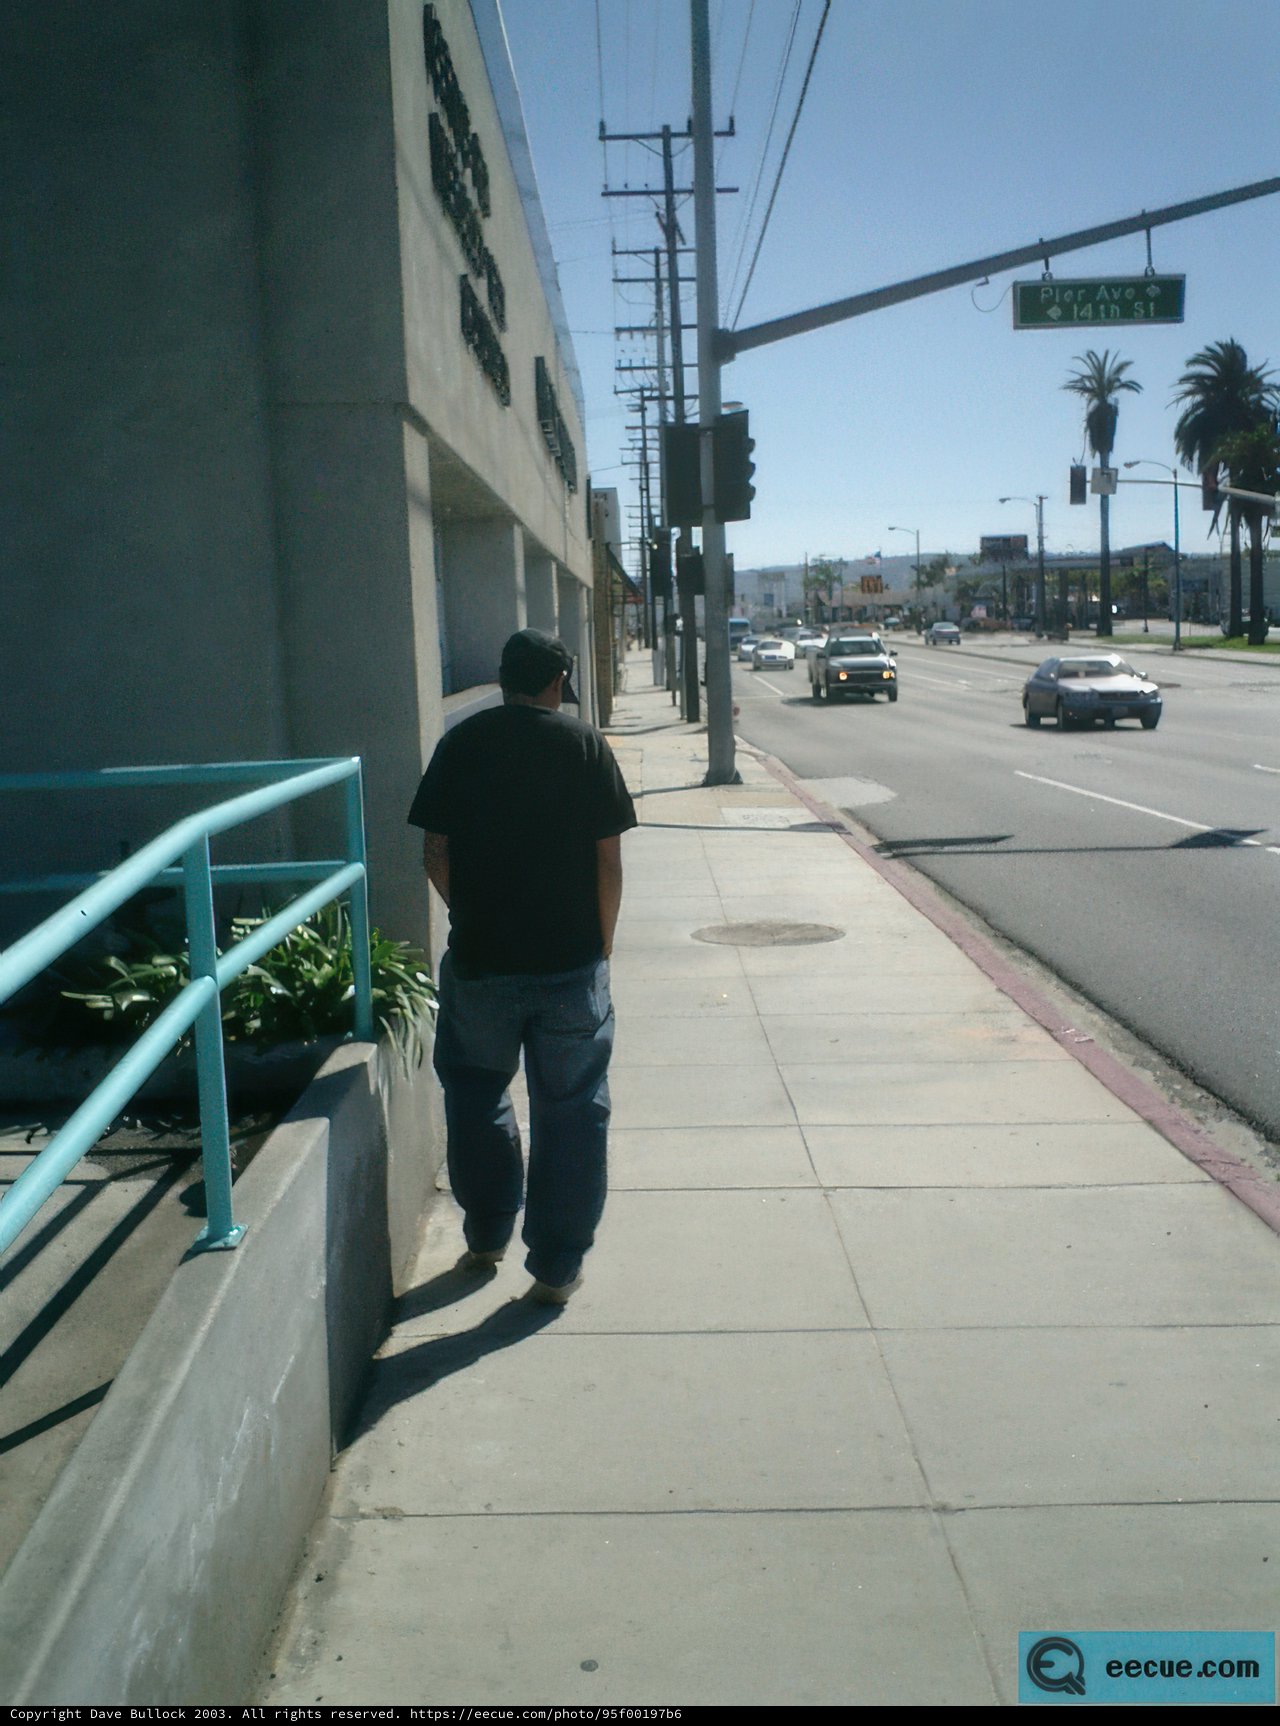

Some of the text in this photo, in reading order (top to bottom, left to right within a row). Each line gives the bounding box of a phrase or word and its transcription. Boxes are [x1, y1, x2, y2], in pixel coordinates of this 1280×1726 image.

[1041, 285, 1136, 303] Pier Ave
[1073, 302, 1156, 321] 14th St
